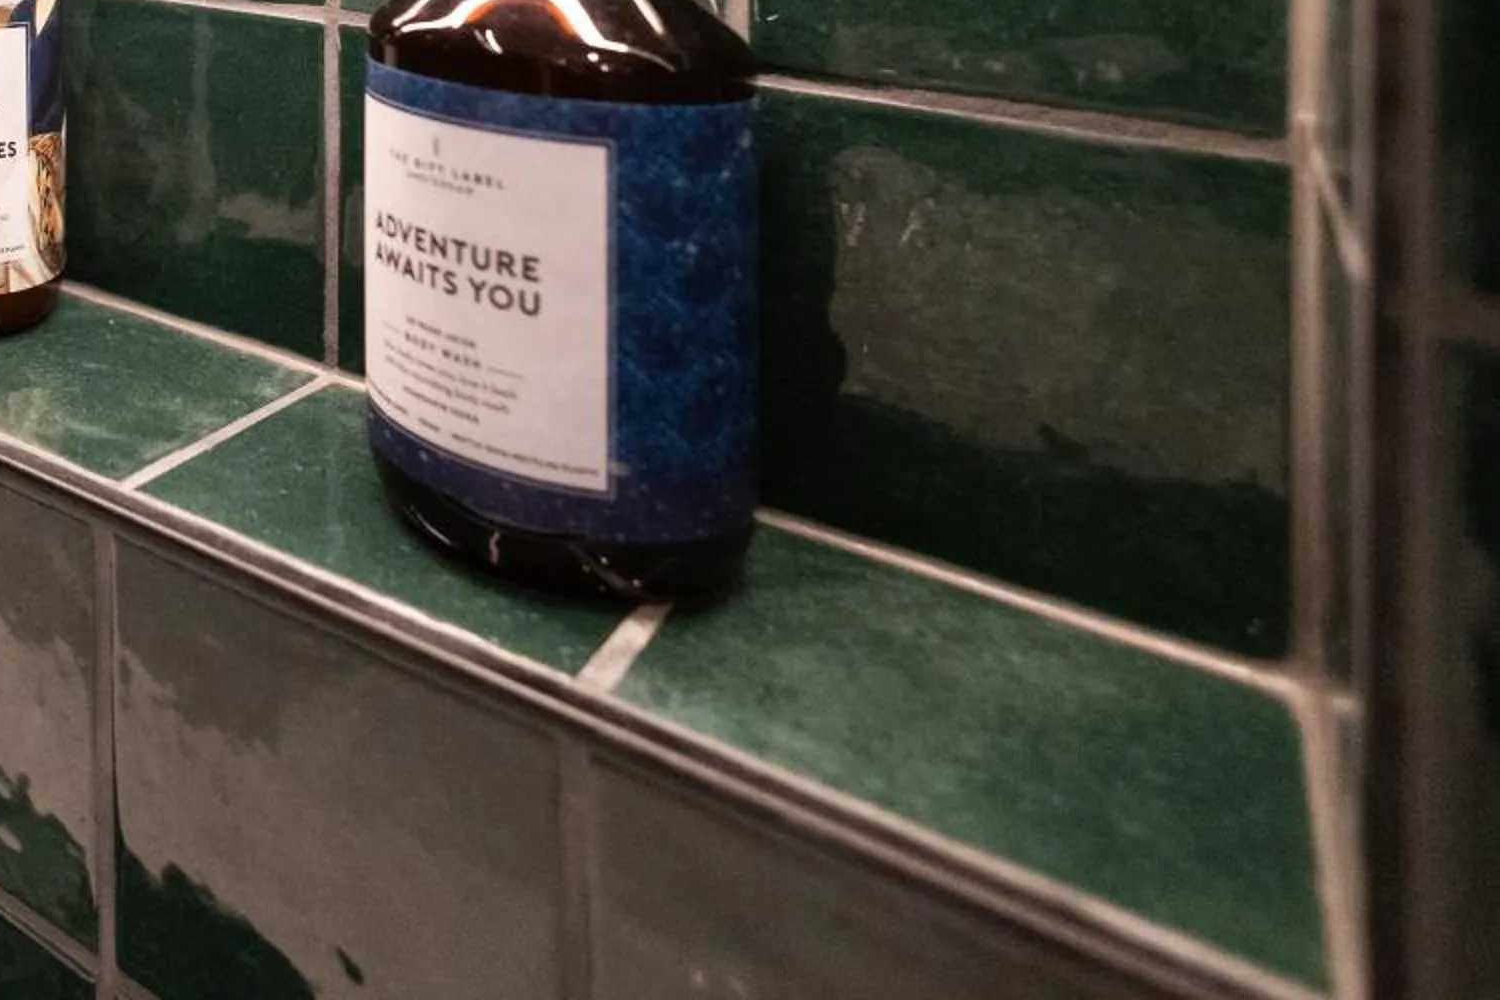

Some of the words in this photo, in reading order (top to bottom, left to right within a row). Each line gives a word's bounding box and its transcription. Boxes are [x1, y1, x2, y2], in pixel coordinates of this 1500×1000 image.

[452, 168, 506, 191] LABEL
[374, 242, 458, 296] AWAITS
[468, 276, 541, 317] YOU
[375, 210, 540, 283] ADVENTURE
